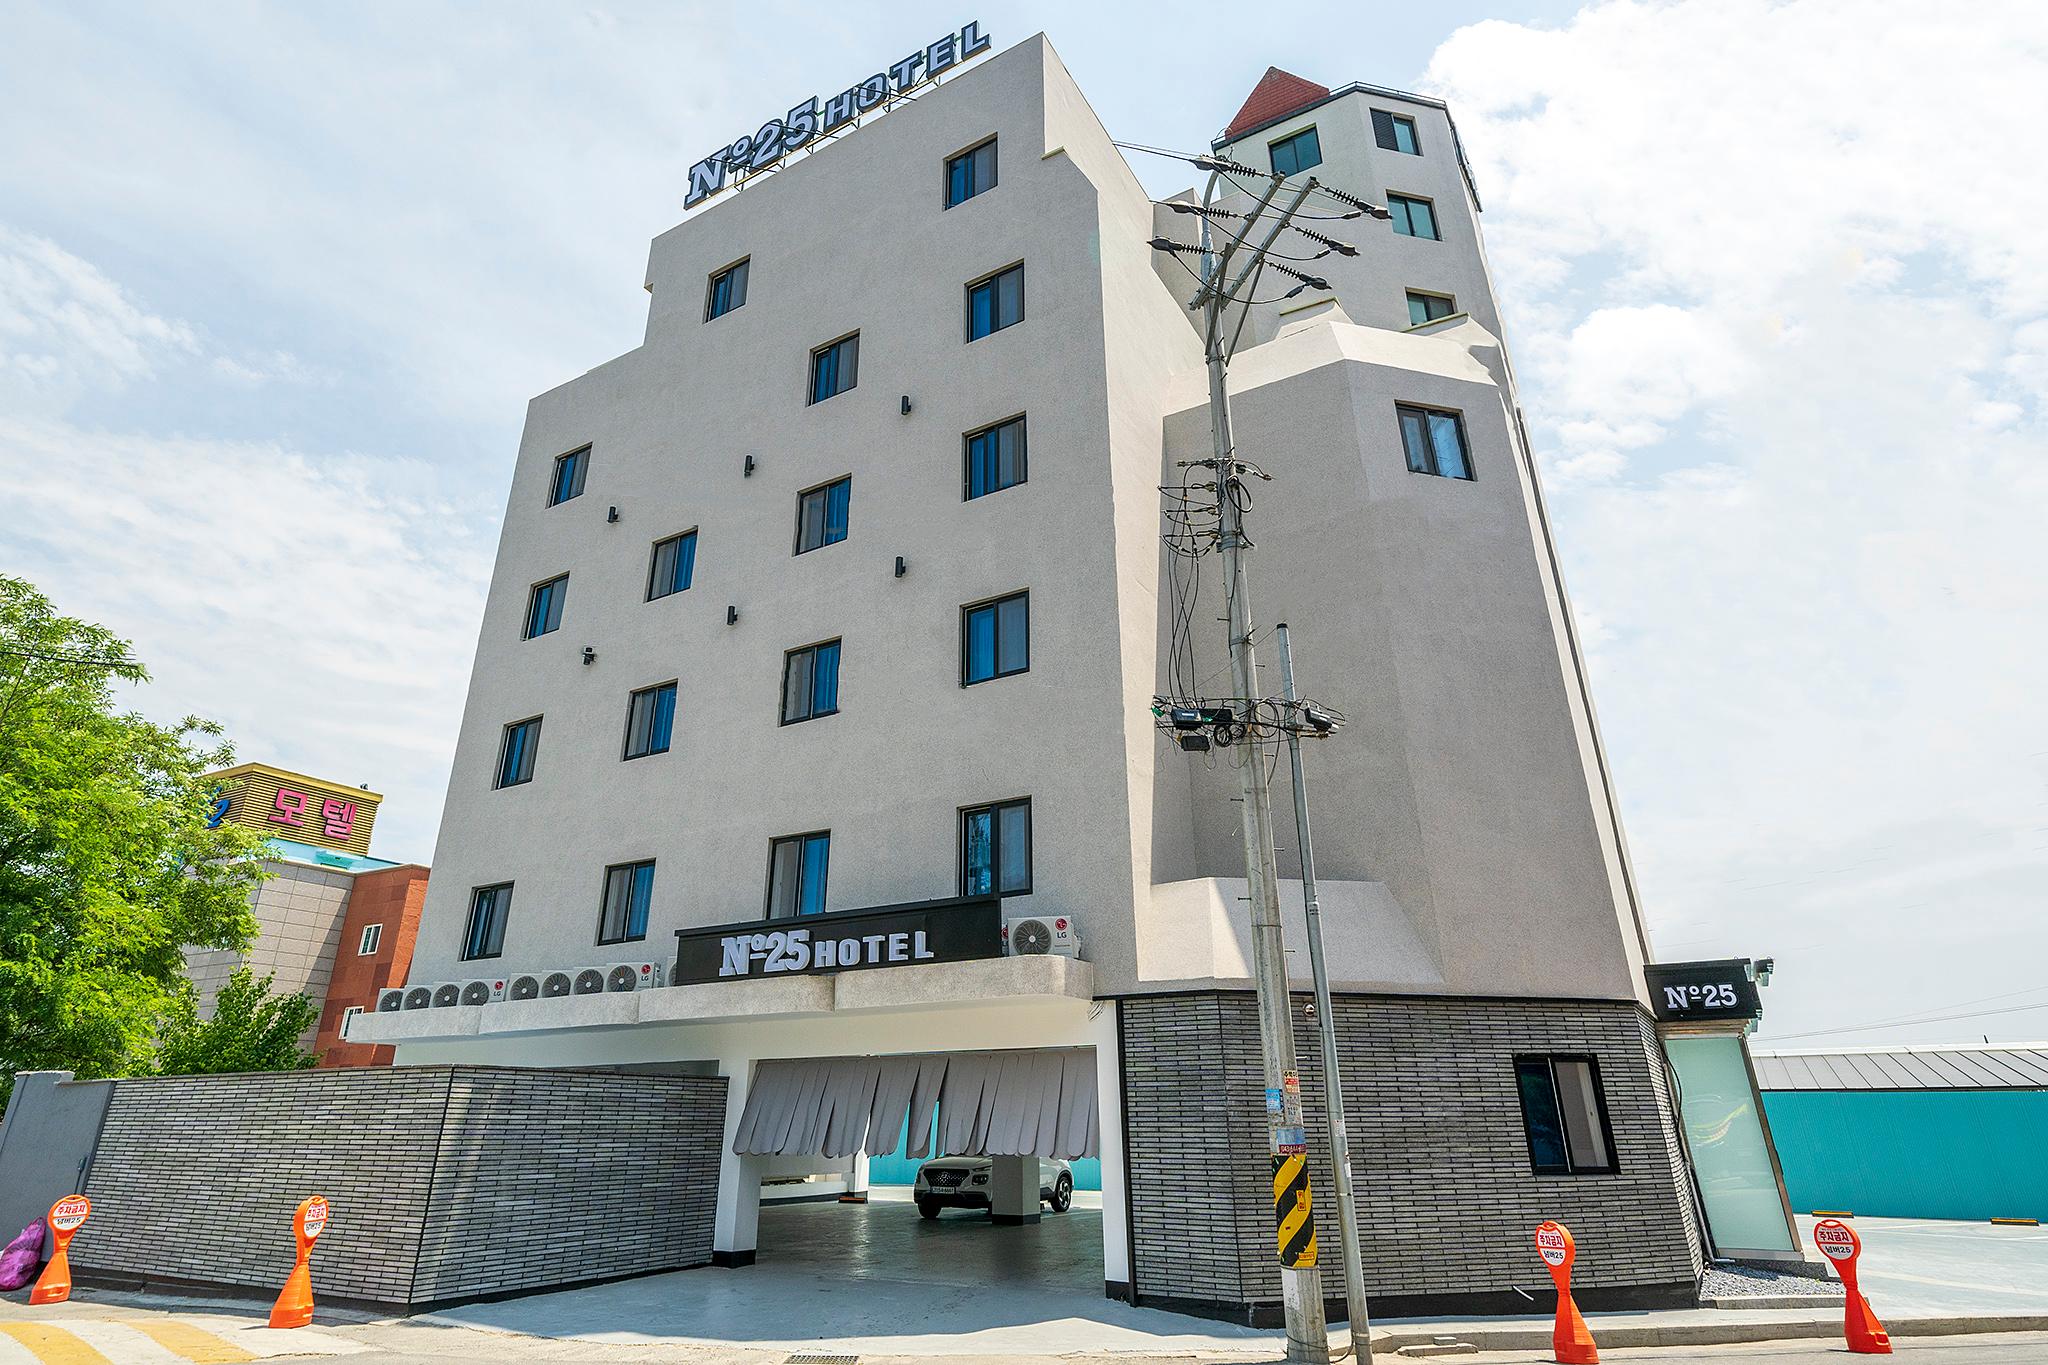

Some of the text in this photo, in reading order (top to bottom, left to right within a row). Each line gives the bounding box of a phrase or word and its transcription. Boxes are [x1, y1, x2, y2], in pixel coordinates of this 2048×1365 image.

[823, 20, 991, 134] HOTEL
[267, 788, 358, 840] 모텔
[1056, 931, 1067, 939] LG
[814, 931, 935, 968] HOTEL
[57, 1204, 86, 1215] 주차금지
[1539, 1234, 1563, 1247] 주차금지
[1818, 1231, 1850, 1242] 주차금지
[1824, 1245, 1852, 1254] 넘버25
